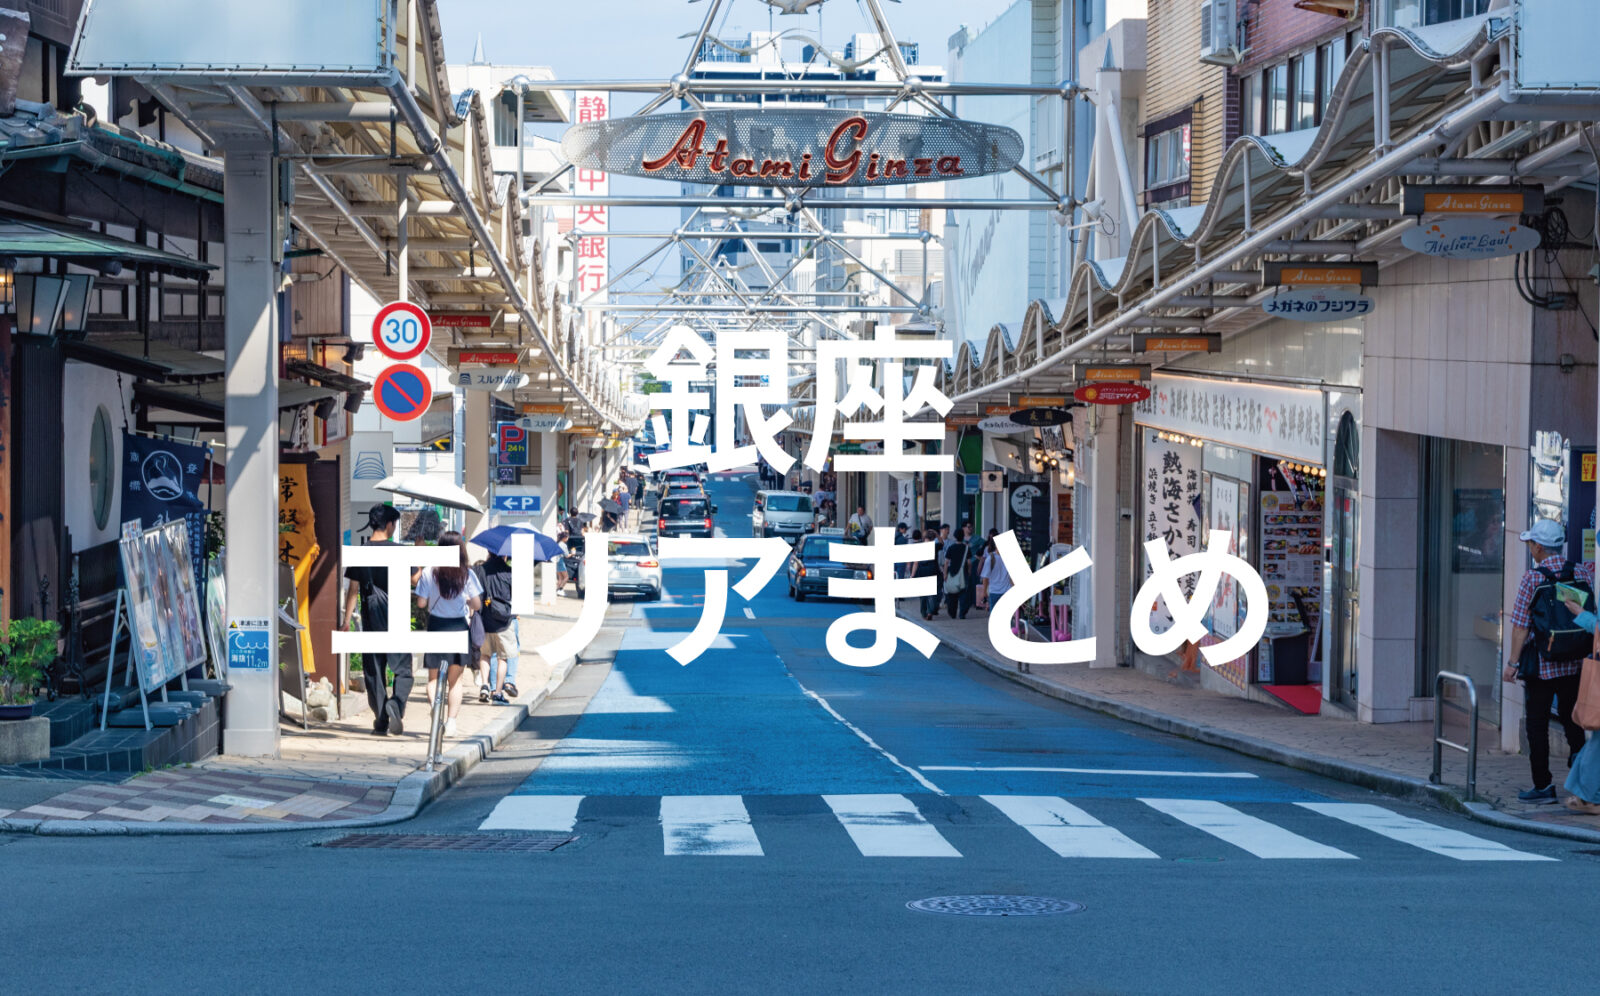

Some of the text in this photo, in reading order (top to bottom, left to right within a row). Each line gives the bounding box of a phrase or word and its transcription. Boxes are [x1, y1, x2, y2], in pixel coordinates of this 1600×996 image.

[642, 117, 965, 185] Atami Ginza
[578, 96, 607, 292] 静中央銀行
[1437, 195, 1511, 210] Atami Ginza
[1425, 234, 1474, 253] Atelier
[1291, 269, 1352, 283] Atami Ginza
[1268, 300, 1369, 313] メガネのフジワラ
[385, 318, 418, 344] 30
[501, 426, 525, 452] P
[507, 444, 525, 453] 24h
[521, 497, 534, 511] P
